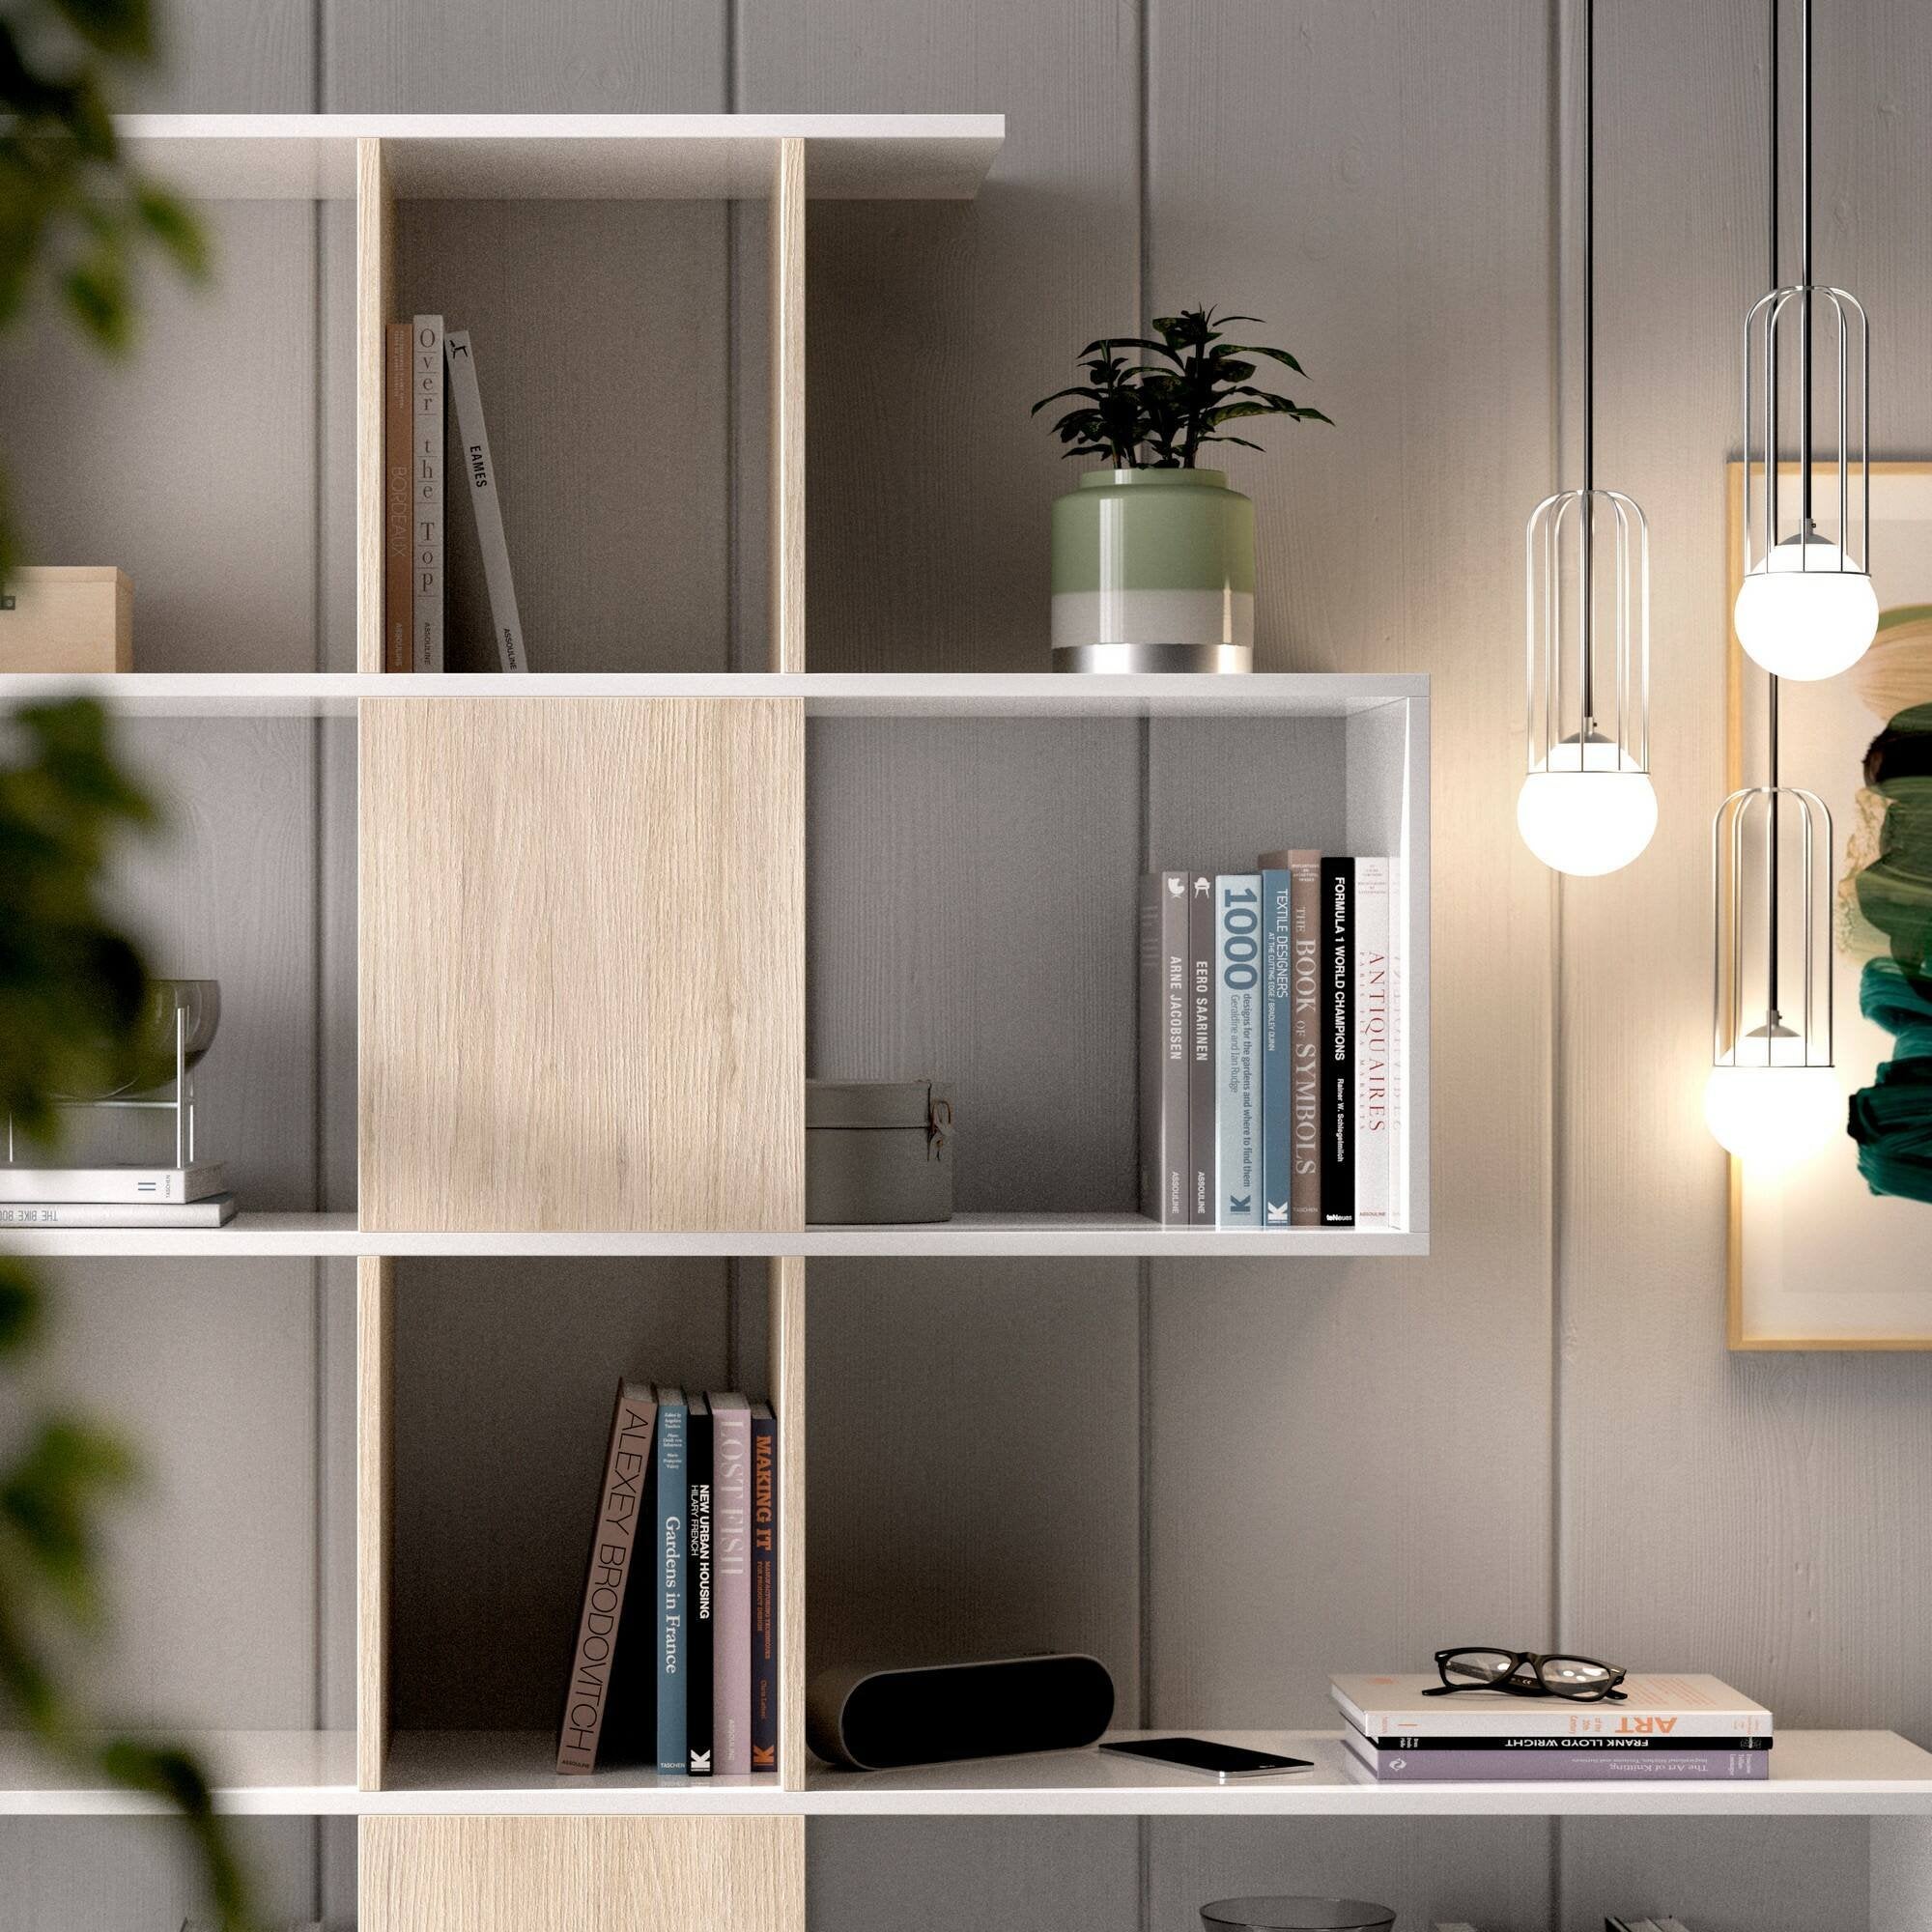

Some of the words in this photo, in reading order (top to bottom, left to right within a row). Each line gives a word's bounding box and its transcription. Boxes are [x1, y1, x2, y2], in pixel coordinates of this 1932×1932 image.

[420, 328, 435, 411] Over
[422, 440, 434, 498] the
[469, 445, 488, 488] EAMES
[391, 466, 407, 557] BORDEAUX
[421, 522, 434, 592] Top
[503, 628, 518, 670] ASSOULINE
[1276, 889, 1289, 932] TEXTILE
[1295, 906, 1306, 932] THE
[1335, 877, 1345, 933] FORMULA
[1224, 888, 1258, 990] 1000
[1267, 932, 1275, 941] AT
[1170, 956, 1182, 989] ARNE
[1196, 961, 1208, 993] EERO
[1276, 936, 1289, 998] DESIGNERS
[1295, 939, 1316, 1012] BOOK
[1335, 946, 1345, 988] WORLD
[1170, 994, 1182, 1060] JACOBSEN
[1196, 997, 1208, 1061] SAARINEN
[1231, 994, 1240, 1033] Geraldine
[1241, 993, 1252, 1026] designs
[1295, 1020, 1306, 1037] OF
[1335, 991, 1345, 1061] CHAMPIONS
[1231, 1036, 1240, 1051] and
[1231, 1052, 1240, 1065] Ian
[1365, 952, 1385, 1131] ANTIQUAIRES
[1229, 1066, 1240, 1093] Rudge
[1241, 1057, 1252, 1090] gardens
[1295, 1043, 1316, 1175] SYMBOLS
[1337, 1103, 1344, 1112] W.
[1244, 1137, 1252, 1146] to
[1335, 1113, 1344, 1161] Schlegelmilch
[17, 1210, 38, 1222] BIKE
[42, 1210, 58, 1222] THE
[606, 1408, 649, 1536] ALEXEY
[721, 1420, 744, 1497] LOST
[756, 1435, 771, 1522] MAKING
[691, 1485, 699, 1517] HILARY
[699, 1485, 709, 1515] NEW
[666, 1517, 680, 1588] Gardens
[691, 1519, 699, 1556] FRENCH
[699, 1517, 709, 1559] URBAN
[721, 1507, 744, 1575] FISH
[756, 1528, 771, 1551] IT
[666, 1594, 680, 1609] in
[699, 1562, 709, 1619] HOUSING
[566, 1544, 627, 1752] BRODOVITCH
[666, 1614, 680, 1674] France
[1614, 1716, 1678, 1733] ART
